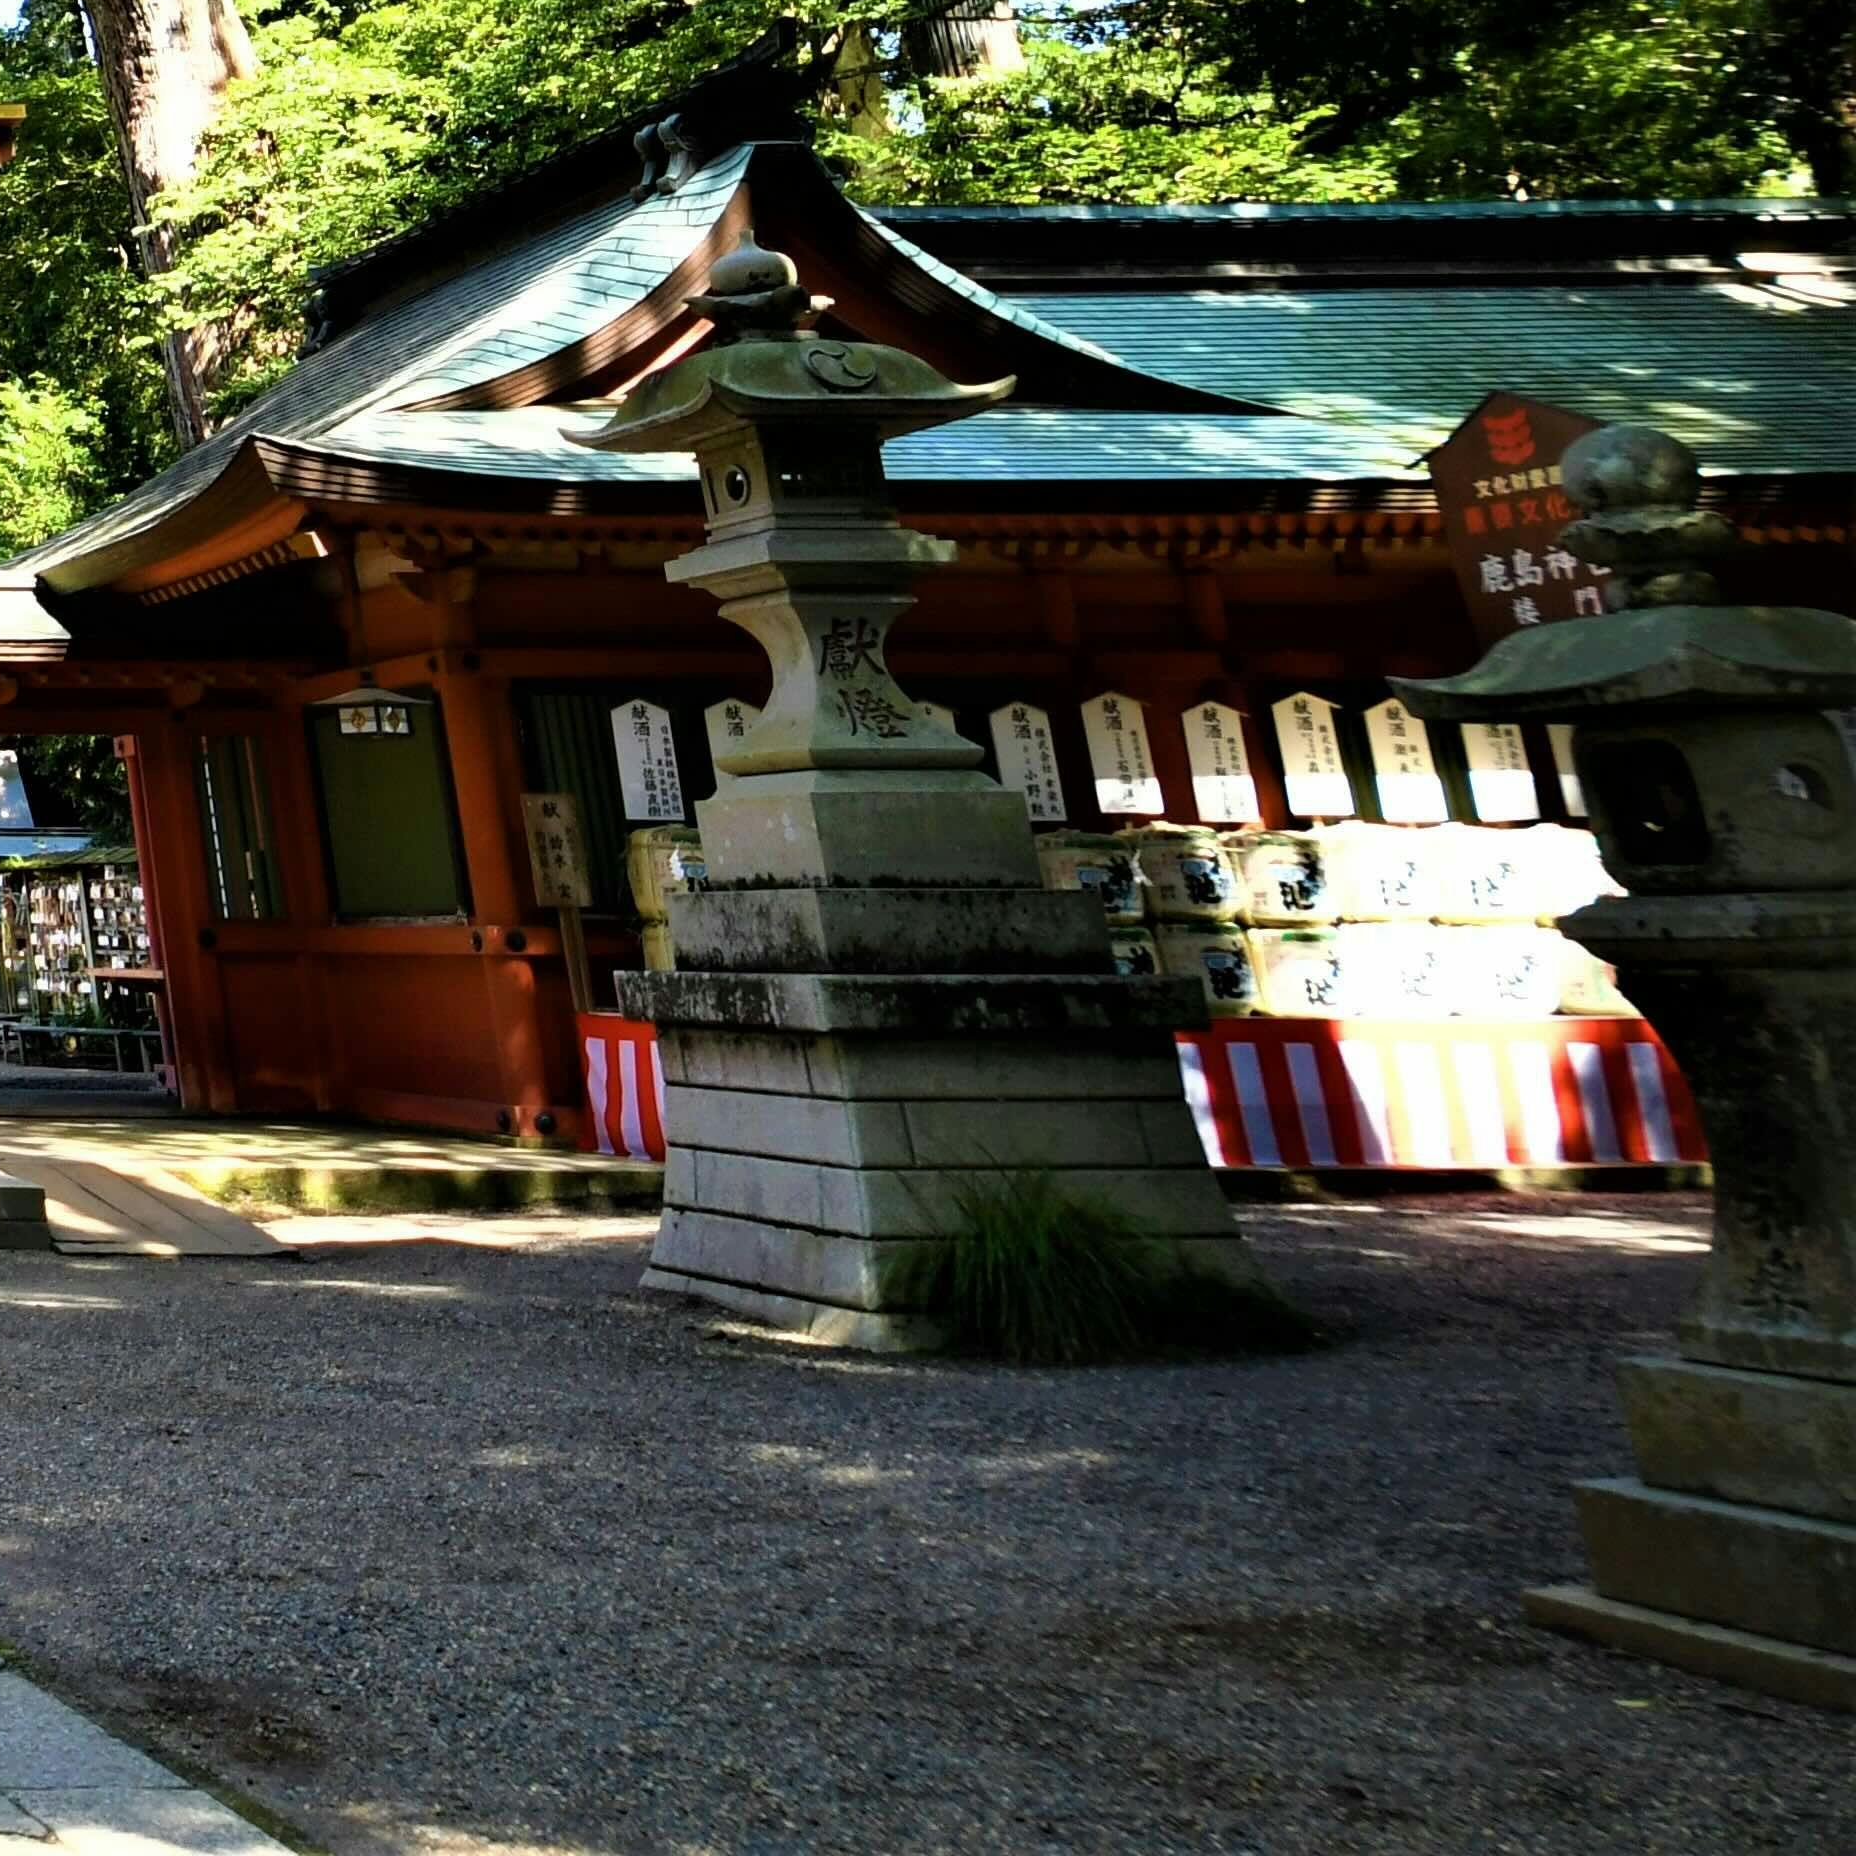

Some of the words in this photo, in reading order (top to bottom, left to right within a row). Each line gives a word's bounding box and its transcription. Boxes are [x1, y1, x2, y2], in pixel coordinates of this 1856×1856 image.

[1463, 489, 1580, 534] 重要文化
[632, 704, 650, 737] 献酒
[725, 704, 745, 737] 献酒
[1011, 707, 1031, 739] 献酒
[1103, 700, 1122, 730] 献酒
[1202, 707, 1222, 739] 献酒
[1293, 700, 1313, 731] 献酒
